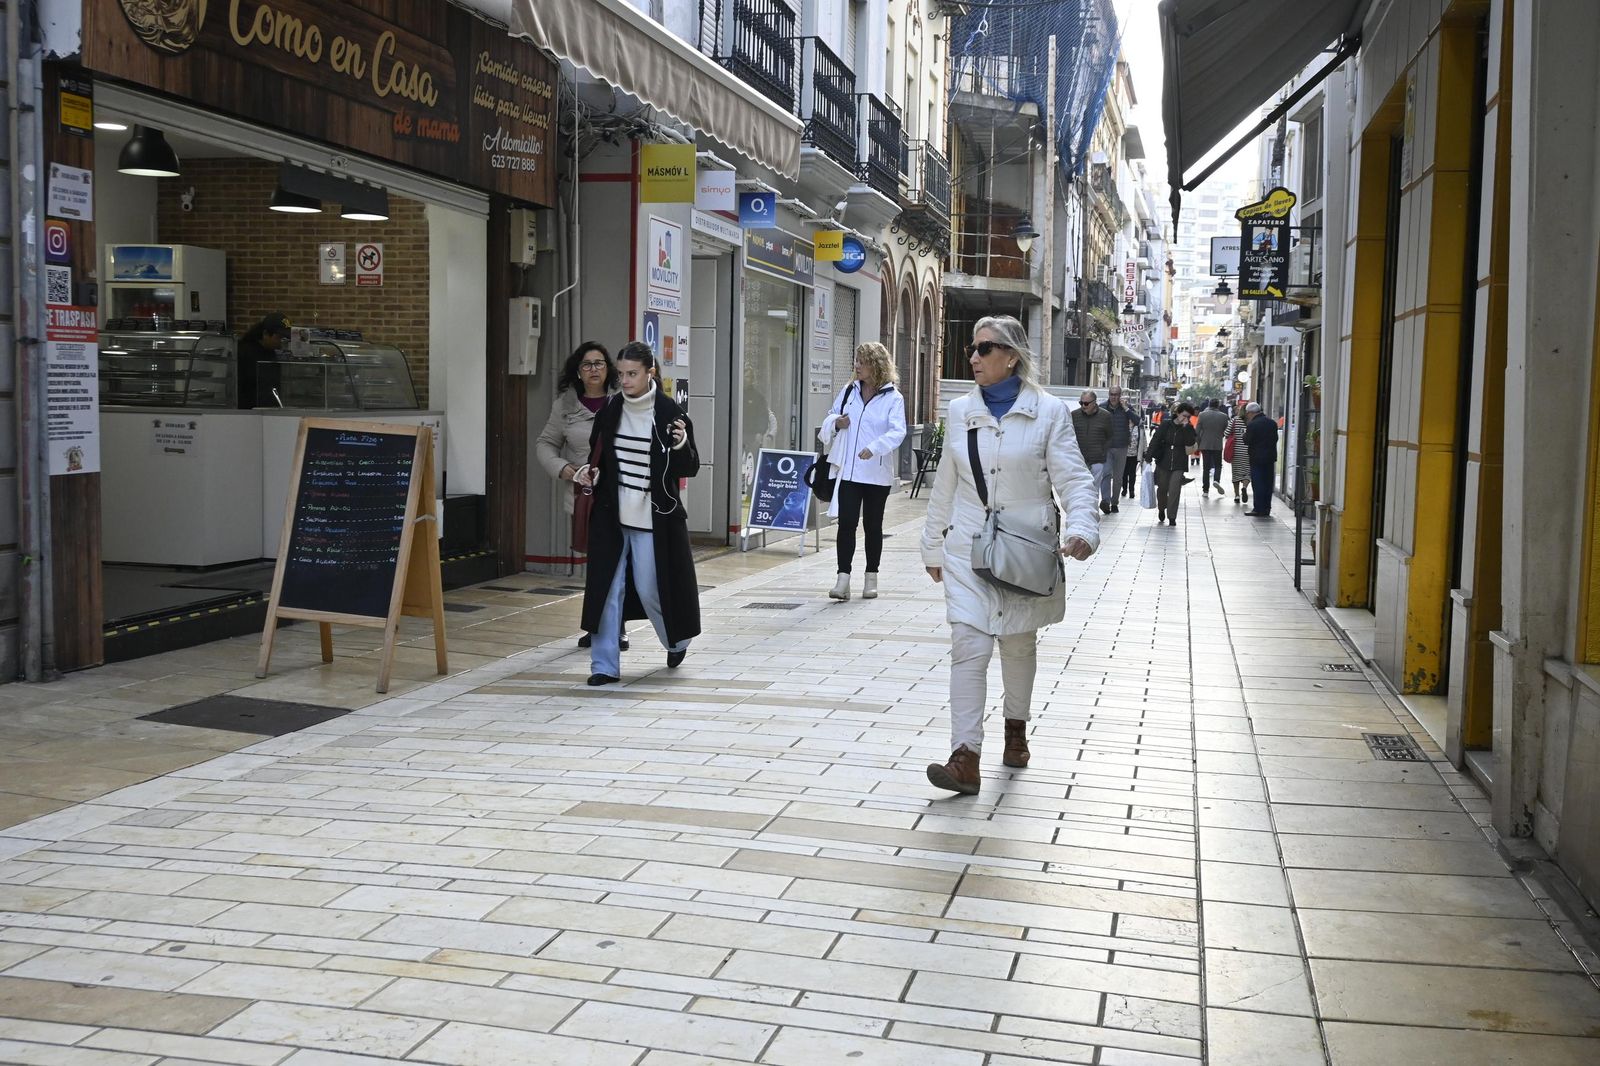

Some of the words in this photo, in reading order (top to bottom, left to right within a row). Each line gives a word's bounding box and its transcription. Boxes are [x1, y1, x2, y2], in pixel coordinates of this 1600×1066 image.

[229, 0, 323, 63] Como
[331, 36, 366, 80] en
[372, 31, 438, 108] Casa
[521, 74, 552, 99] casera
[473, 84, 495, 109] lista
[496, 98, 520, 120] para
[522, 103, 551, 130] llevar!
[393, 106, 413, 134] de
[491, 154, 505, 168] 623
[506, 155, 521, 170] 727
[521, 157, 536, 171] 888
[647, 165, 689, 177] MÁSMÓVL
[700, 185, 731, 196] simyo
[652, 266, 679, 285] MOVILCITY
[54, 309, 96, 328] TRASPASA
[1116, 324, 1144, 334] CHINO
